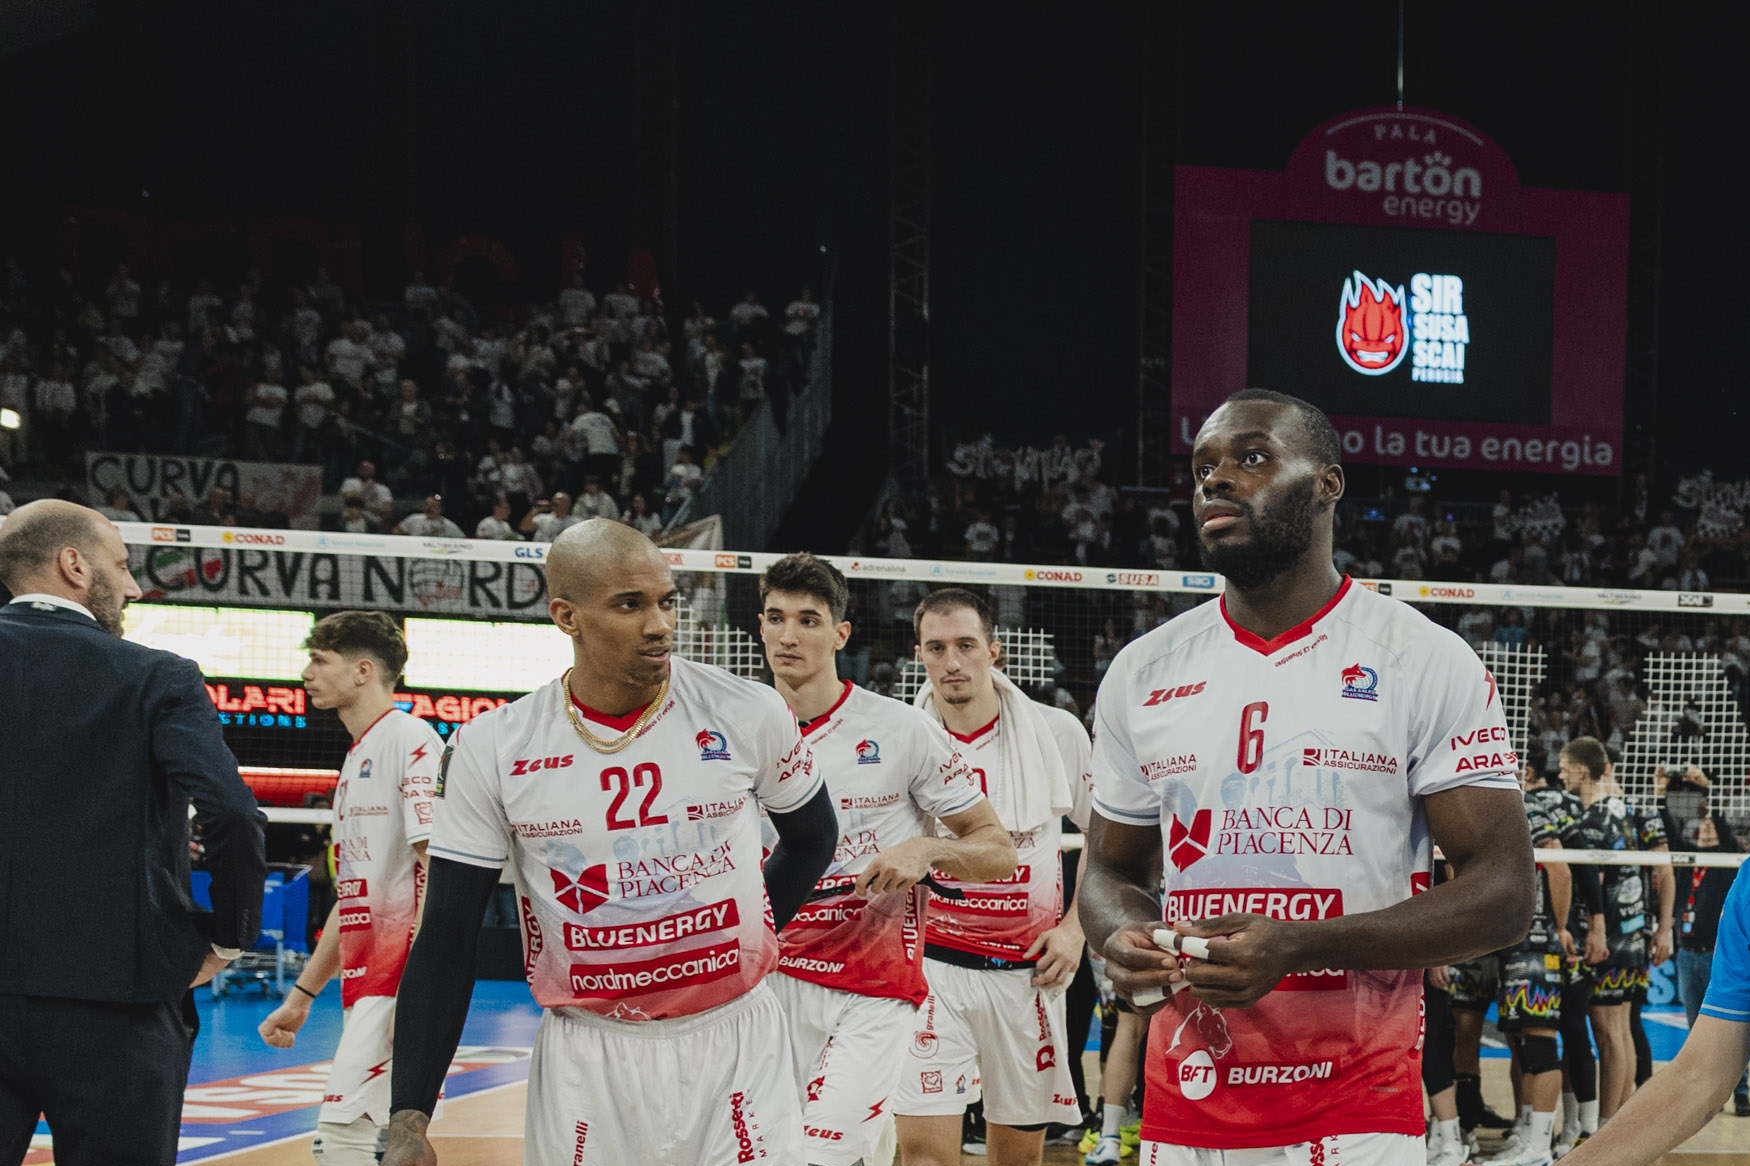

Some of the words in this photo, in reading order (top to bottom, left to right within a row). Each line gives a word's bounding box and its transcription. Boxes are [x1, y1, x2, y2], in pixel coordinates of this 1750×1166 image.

[1374, 123, 1438, 145] PALA
[1383, 195, 1481, 224] energy
[1410, 272, 1464, 314] SIR
[1413, 314, 1470, 343] SUSA
[1413, 342, 1465, 369] SCAI
[1375, 426, 1402, 456] la
[1415, 430, 1471, 458] tua
[1481, 434, 1613, 471] energia
[90, 455, 239, 501] CURVA
[235, 533, 284, 545] CONAD
[515, 547, 543, 559] GLS
[146, 546, 341, 602] CURVA
[1037, 571, 1083, 583] CONAD
[1119, 574, 1159, 586] SUSA
[1431, 588, 1475, 599] CONAD
[1237, 701, 1269, 775] 6
[509, 753, 574, 776] Zeus
[1149, 753, 1197, 772] ITALIANA
[1323, 759, 1397, 775] ASSICURAZIONI
[1324, 748, 1398, 767] ITALIANA
[1455, 751, 1504, 773] ARA
[600, 762, 668, 832] 22
[1222, 807, 1310, 831] BANCA
[1322, 808, 1352, 831] DI
[1216, 831, 1354, 856] PIACENZA
[618, 852, 703, 880] BANCA
[1167, 891, 1337, 924] BLUENERGY
[570, 902, 730, 948] BLUENERGY
[572, 947, 740, 992] nordmeccanica
[1181, 1065, 1215, 1083] BFT
[1228, 1062, 1333, 1086] BURZONI
